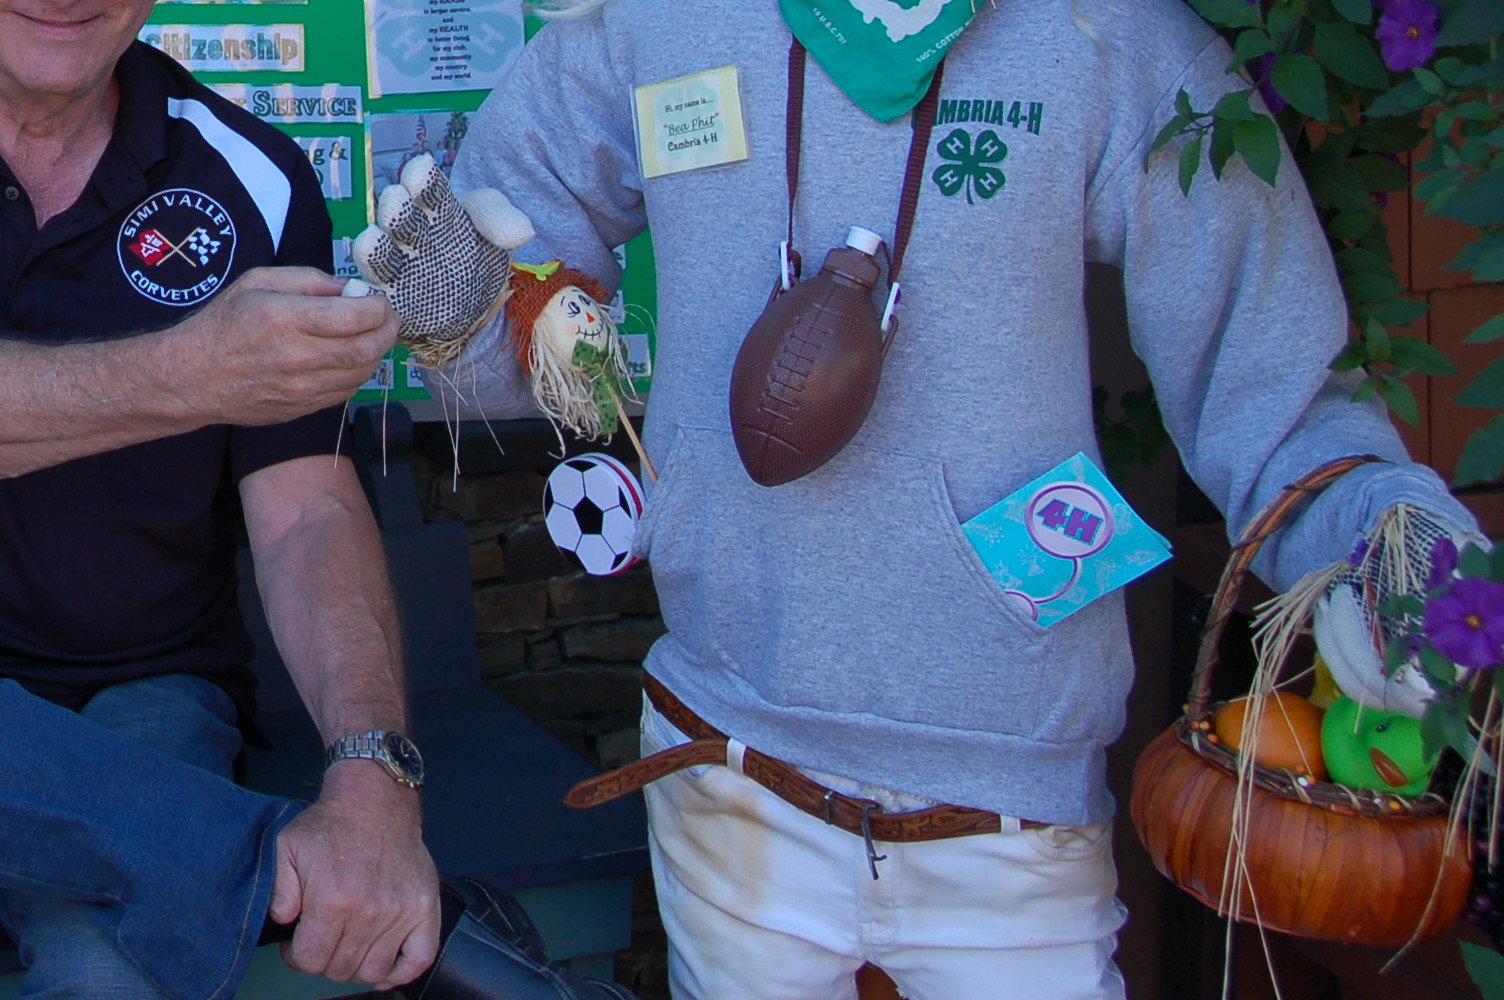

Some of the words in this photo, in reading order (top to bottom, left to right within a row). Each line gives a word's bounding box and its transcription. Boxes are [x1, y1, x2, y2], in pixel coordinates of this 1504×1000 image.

[933, 99, 1004, 126] MBRIA
[1006, 100, 1043, 135] 4-H
[123, 200, 159, 238] SIMI
[162, 193, 232, 236] VALLEY
[130, 269, 218, 301] CORVETTES
